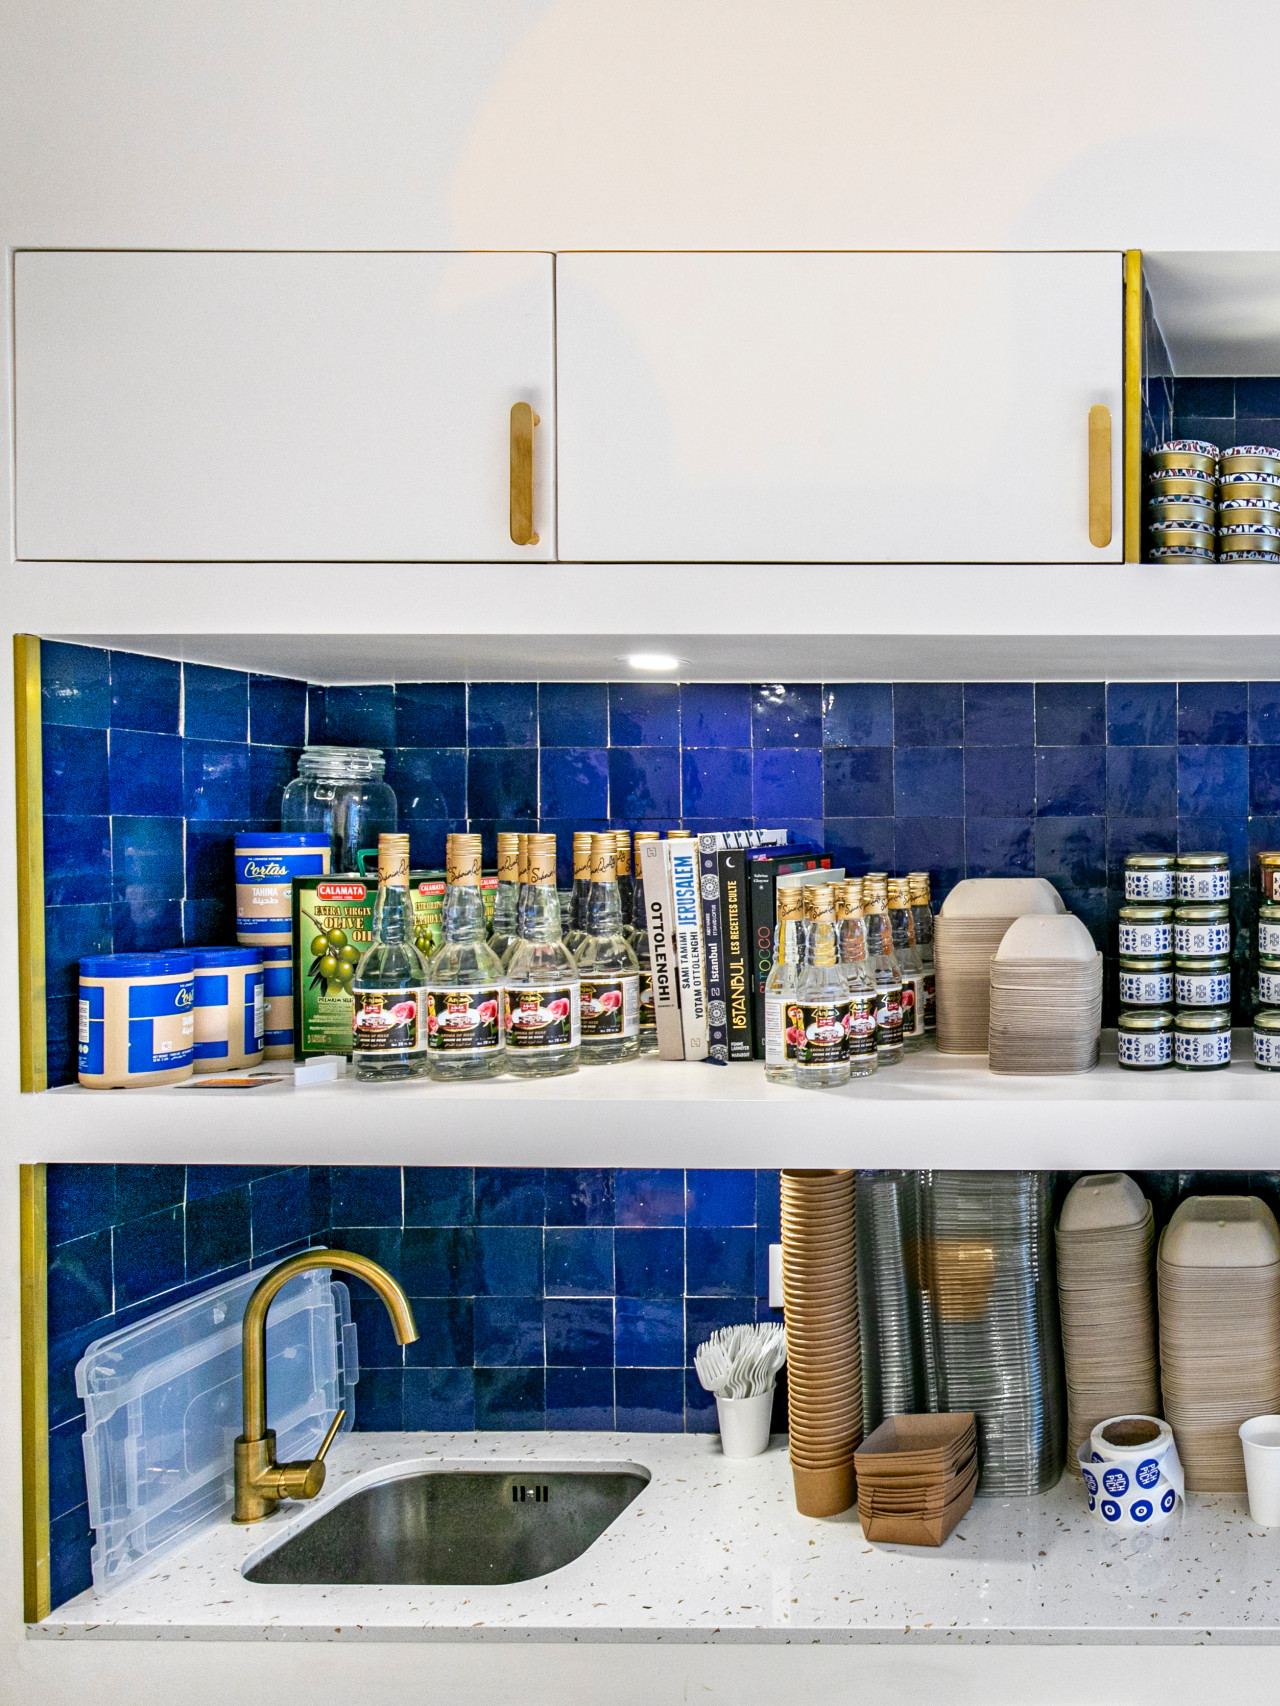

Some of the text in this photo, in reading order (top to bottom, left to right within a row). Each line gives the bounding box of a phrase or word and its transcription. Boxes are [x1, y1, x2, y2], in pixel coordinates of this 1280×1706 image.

[244, 862, 288, 878] Cortas
[252, 888, 278, 897] TAHINA
[320, 886, 363, 895] CALAMATA
[420, 883, 445, 892] CALAMATA
[674, 855, 697, 926] JERUSALEM
[314, 906, 371, 916] EXTRA VIRGIN
[727, 880, 740, 955] LES RECETTES CULTE
[323, 917, 364, 929] OLIVE
[651, 902, 671, 1001] OTTOLENGHI
[679, 932, 690, 989] SAMI TAMIMI
[708, 943, 720, 982] Istanbul
[690, 931, 703, 1019] YOTAM OTTOLENGHI
[730, 958, 747, 1029] ISTANBUL
[1106, 1475, 1117, 1492] PICH
[1115, 1474, 1127, 1491] PICH
[1139, 1466, 1150, 1485] PICH
